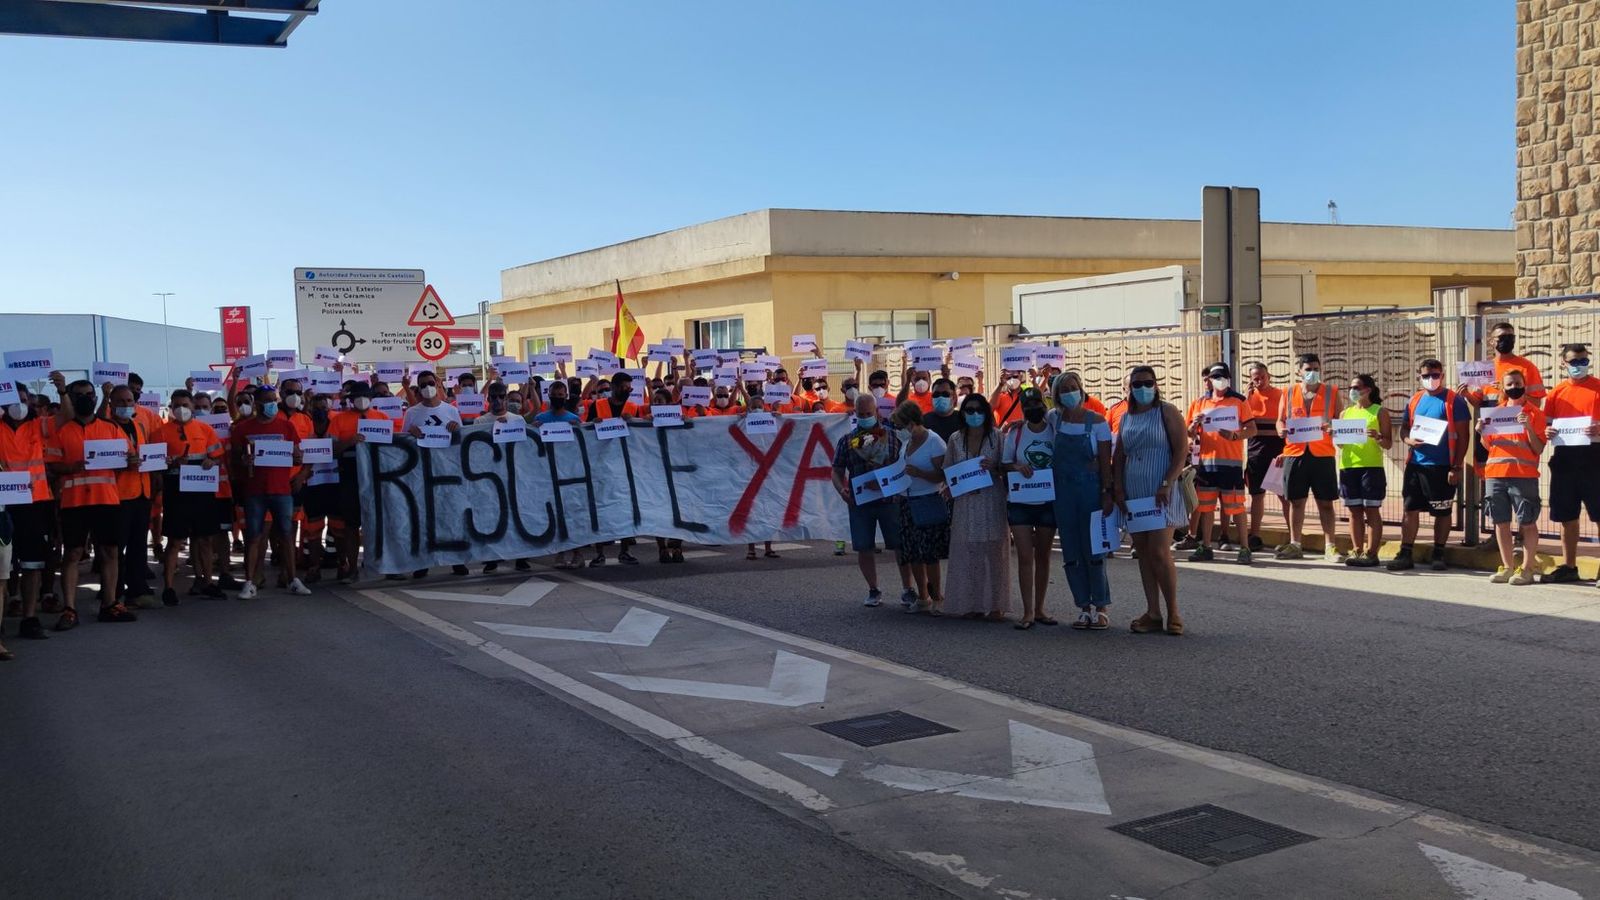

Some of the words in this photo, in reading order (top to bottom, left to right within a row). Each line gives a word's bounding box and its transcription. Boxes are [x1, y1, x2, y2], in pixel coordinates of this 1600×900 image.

[423, 338, 443, 350] 30
[8, 359, 51, 369] #RESCATEYA
[1460, 370, 1493, 379] #RESCATEYA
[359, 426, 391, 436] #RESCATEYA
[182, 474, 216, 483] #RESCATEYA
[728, 418, 842, 538] YA
